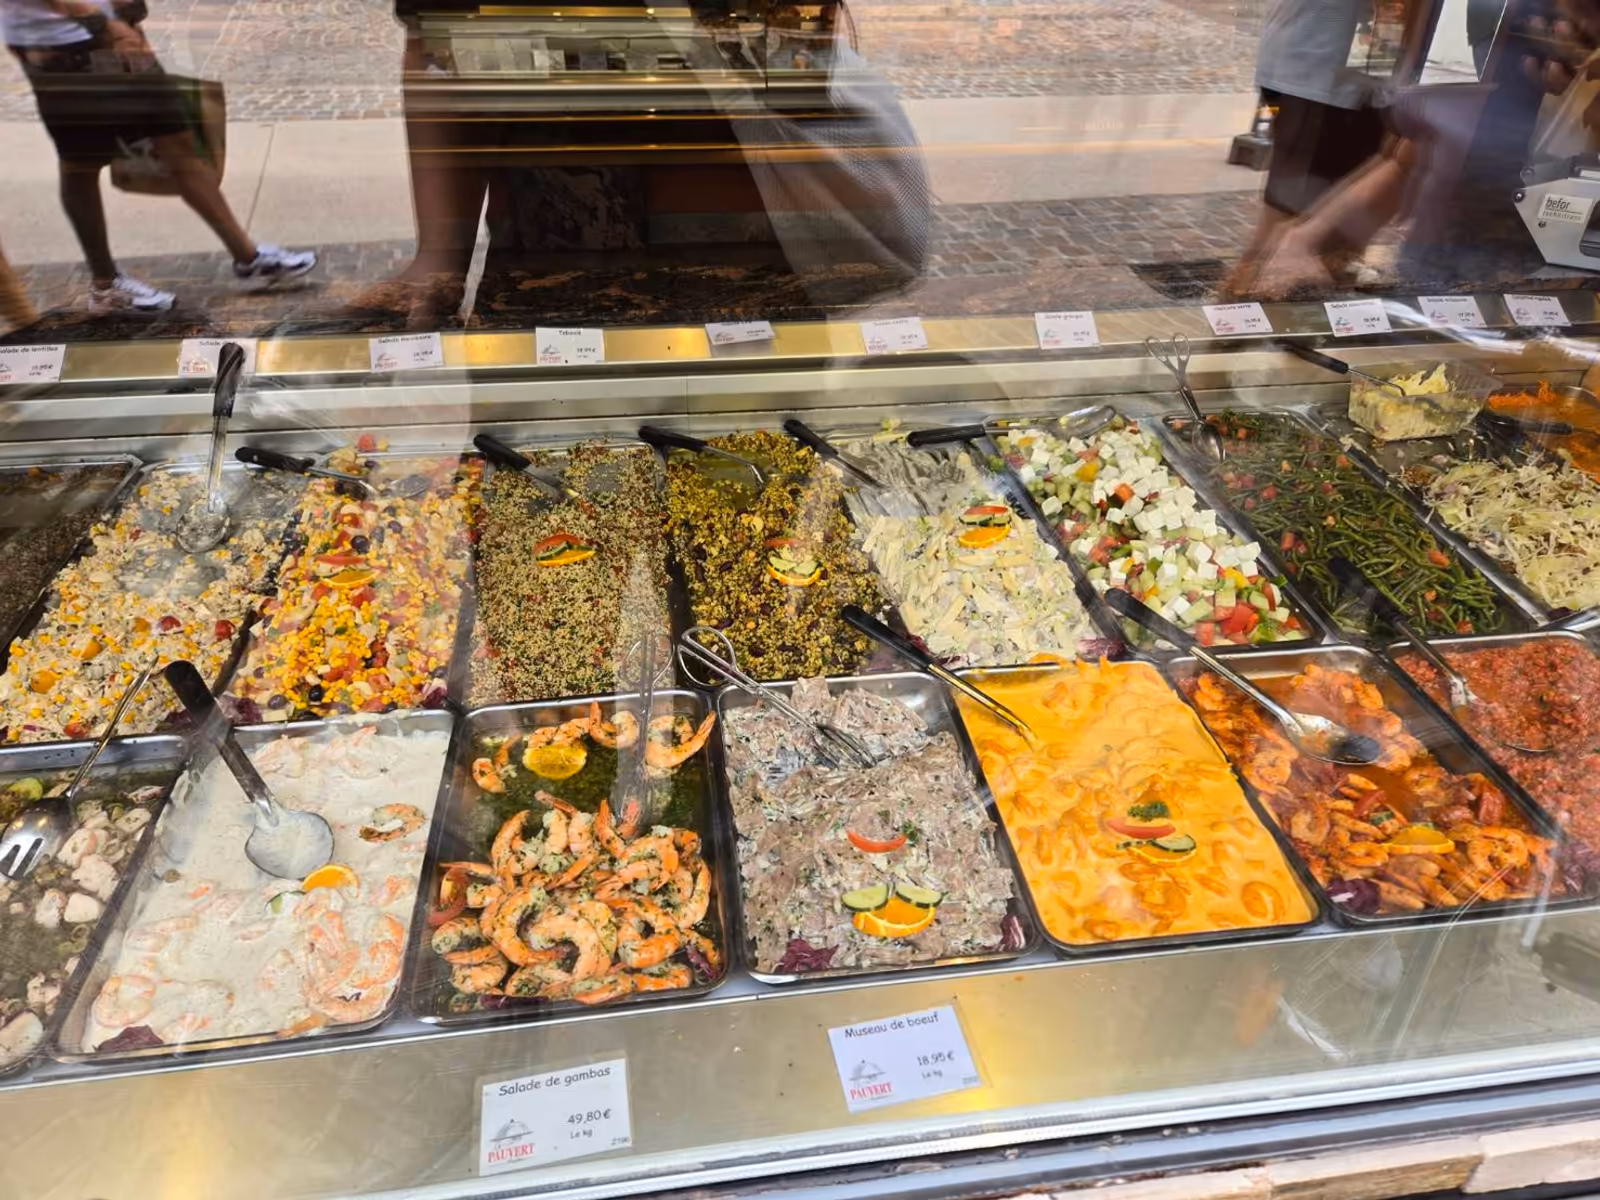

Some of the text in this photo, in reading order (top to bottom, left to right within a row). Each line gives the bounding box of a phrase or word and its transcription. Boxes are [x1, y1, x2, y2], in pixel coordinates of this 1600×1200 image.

[1546, 196, 1570, 210] befor
[844, 1011, 939, 1038] Museau de boeuf
[498, 1066, 611, 1097] Salade de gambas
[850, 1081, 892, 1101] PAUVERT
[570, 1131, 580, 1139] Le
[487, 1142, 535, 1163] PAUVERT
